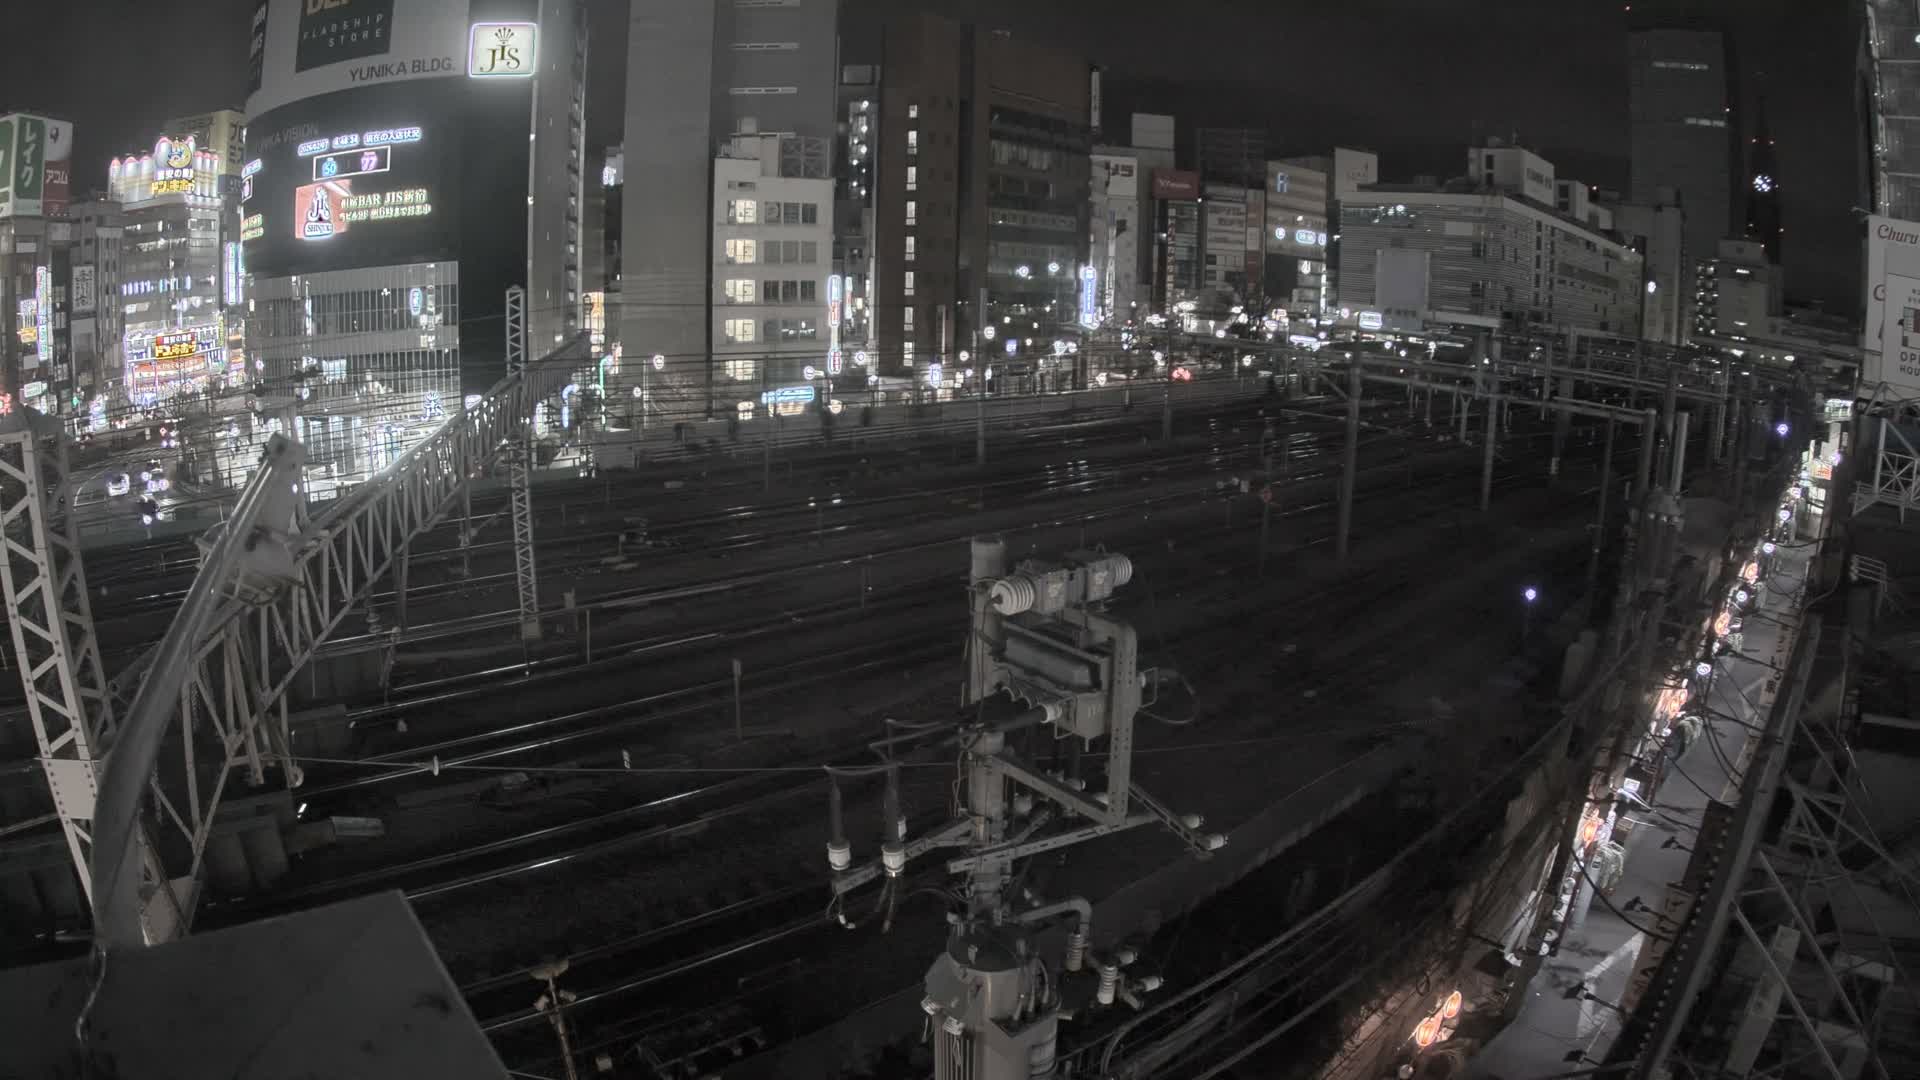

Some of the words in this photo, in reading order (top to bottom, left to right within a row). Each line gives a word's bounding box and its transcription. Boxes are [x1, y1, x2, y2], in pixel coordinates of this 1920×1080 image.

[303, 13, 383, 40] FLAGSHIP
[328, 29, 382, 47] STORE
[349, 61, 407, 82] YUNIKA
[411, 57, 456, 74] BLDG.
[479, 45, 520, 73] JIS
[20, 121, 37, 188] レイク
[45, 169, 68, 185] アコム
[1900, 351, 1920, 364] OP
